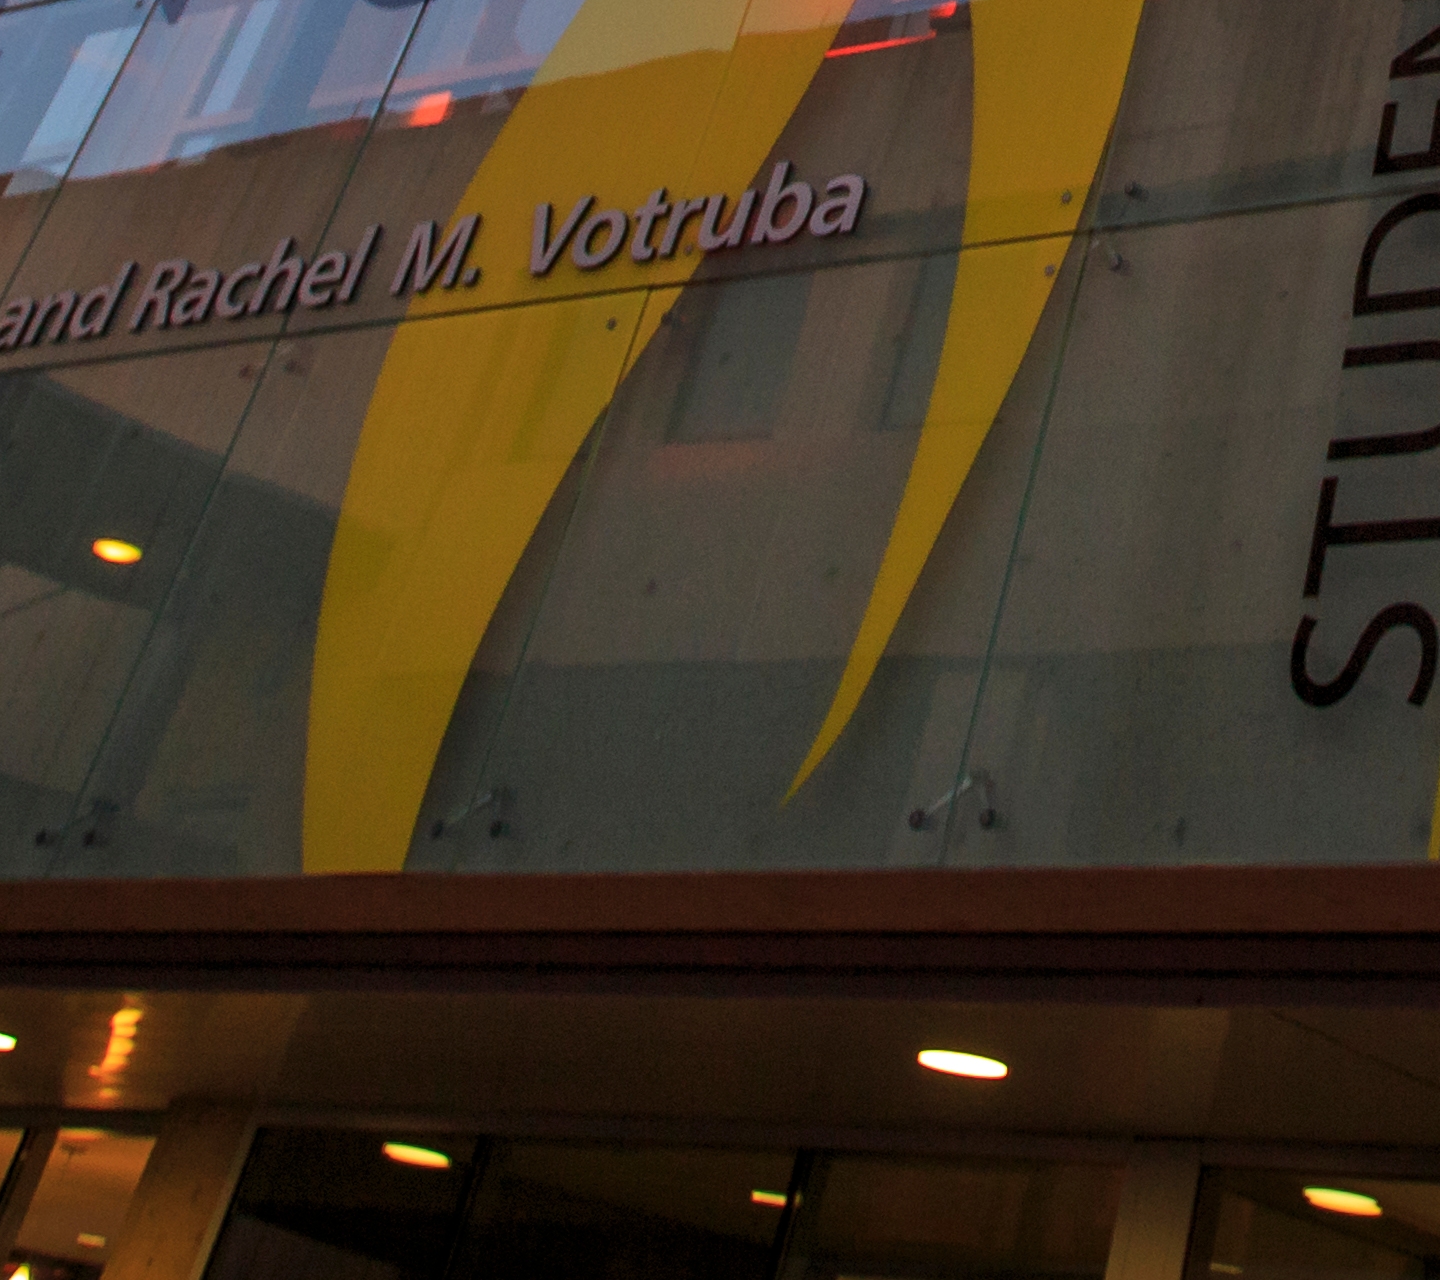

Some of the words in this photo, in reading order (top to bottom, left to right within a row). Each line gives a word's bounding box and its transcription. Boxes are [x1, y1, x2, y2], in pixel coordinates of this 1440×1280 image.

[129, 224, 378, 332] Rachel
[390, 214, 482, 298] M.
[528, 160, 866, 277] Votruba
